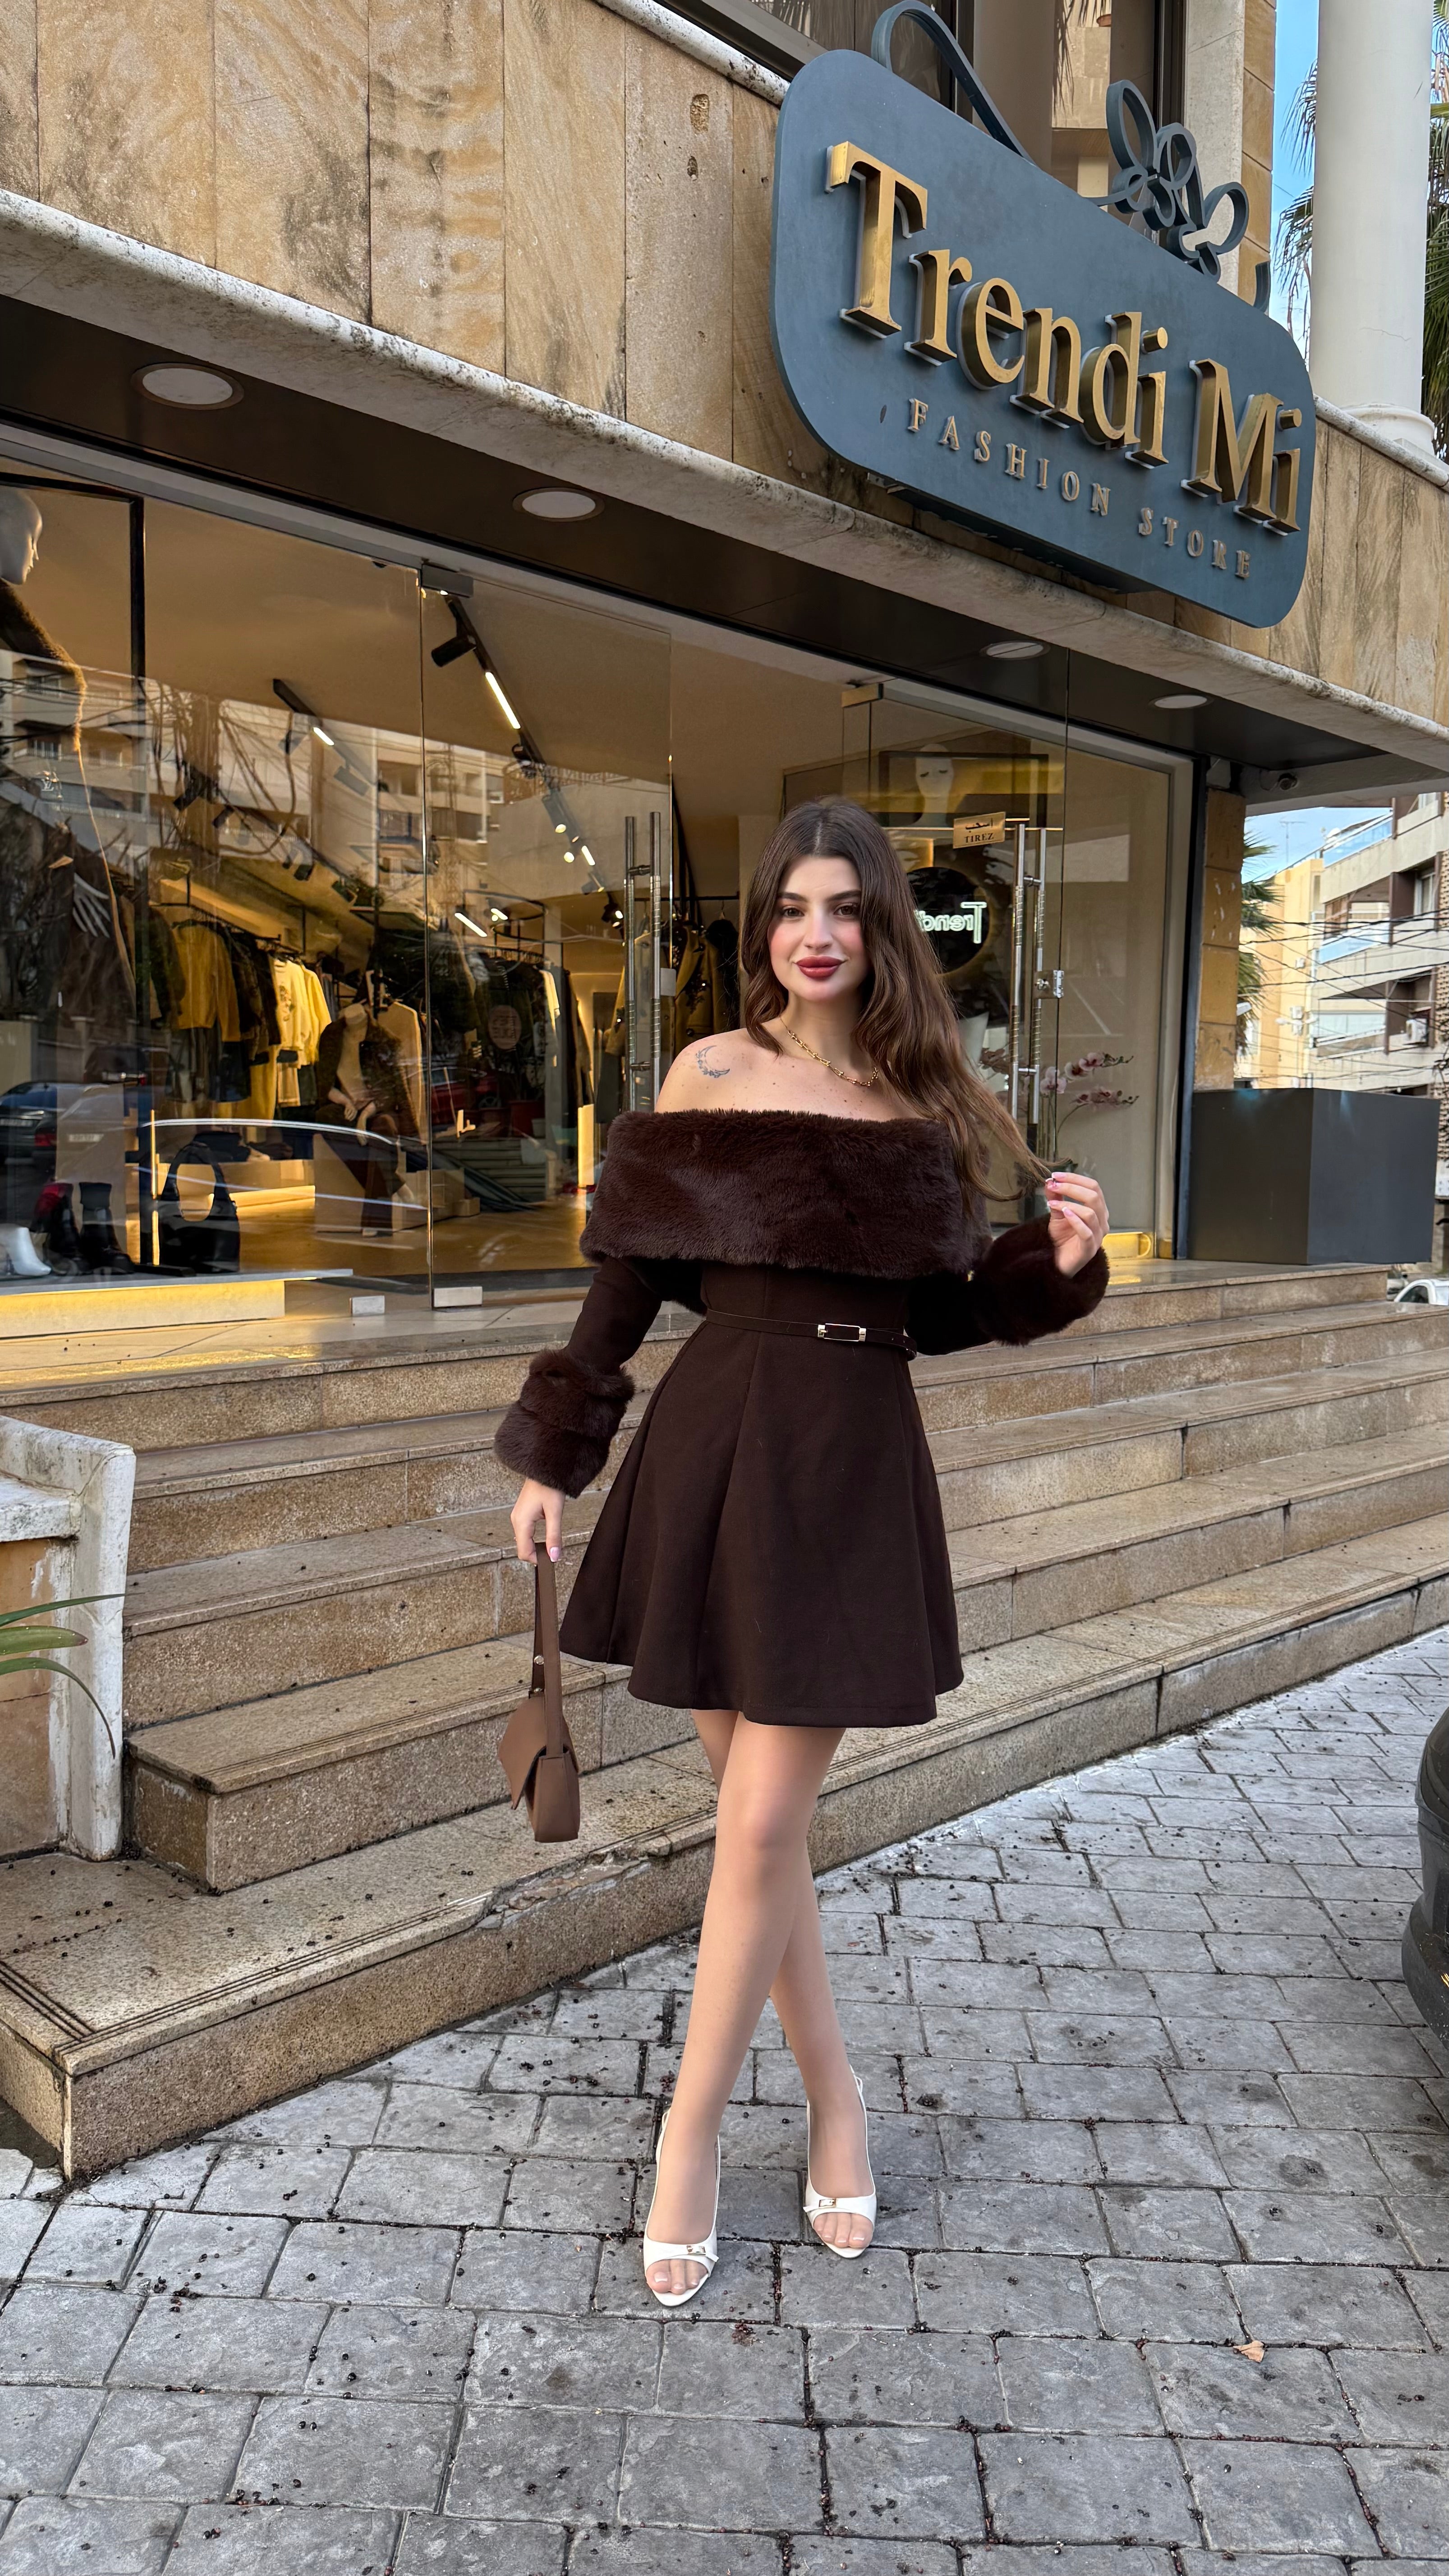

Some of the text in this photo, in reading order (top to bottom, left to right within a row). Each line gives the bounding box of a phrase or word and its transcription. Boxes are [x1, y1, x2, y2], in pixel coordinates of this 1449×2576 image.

[825, 141, 1302, 536] Trendi Mi
[907, 398, 1251, 579] FASHION STORE
[965, 833, 994, 843] TIREZ
